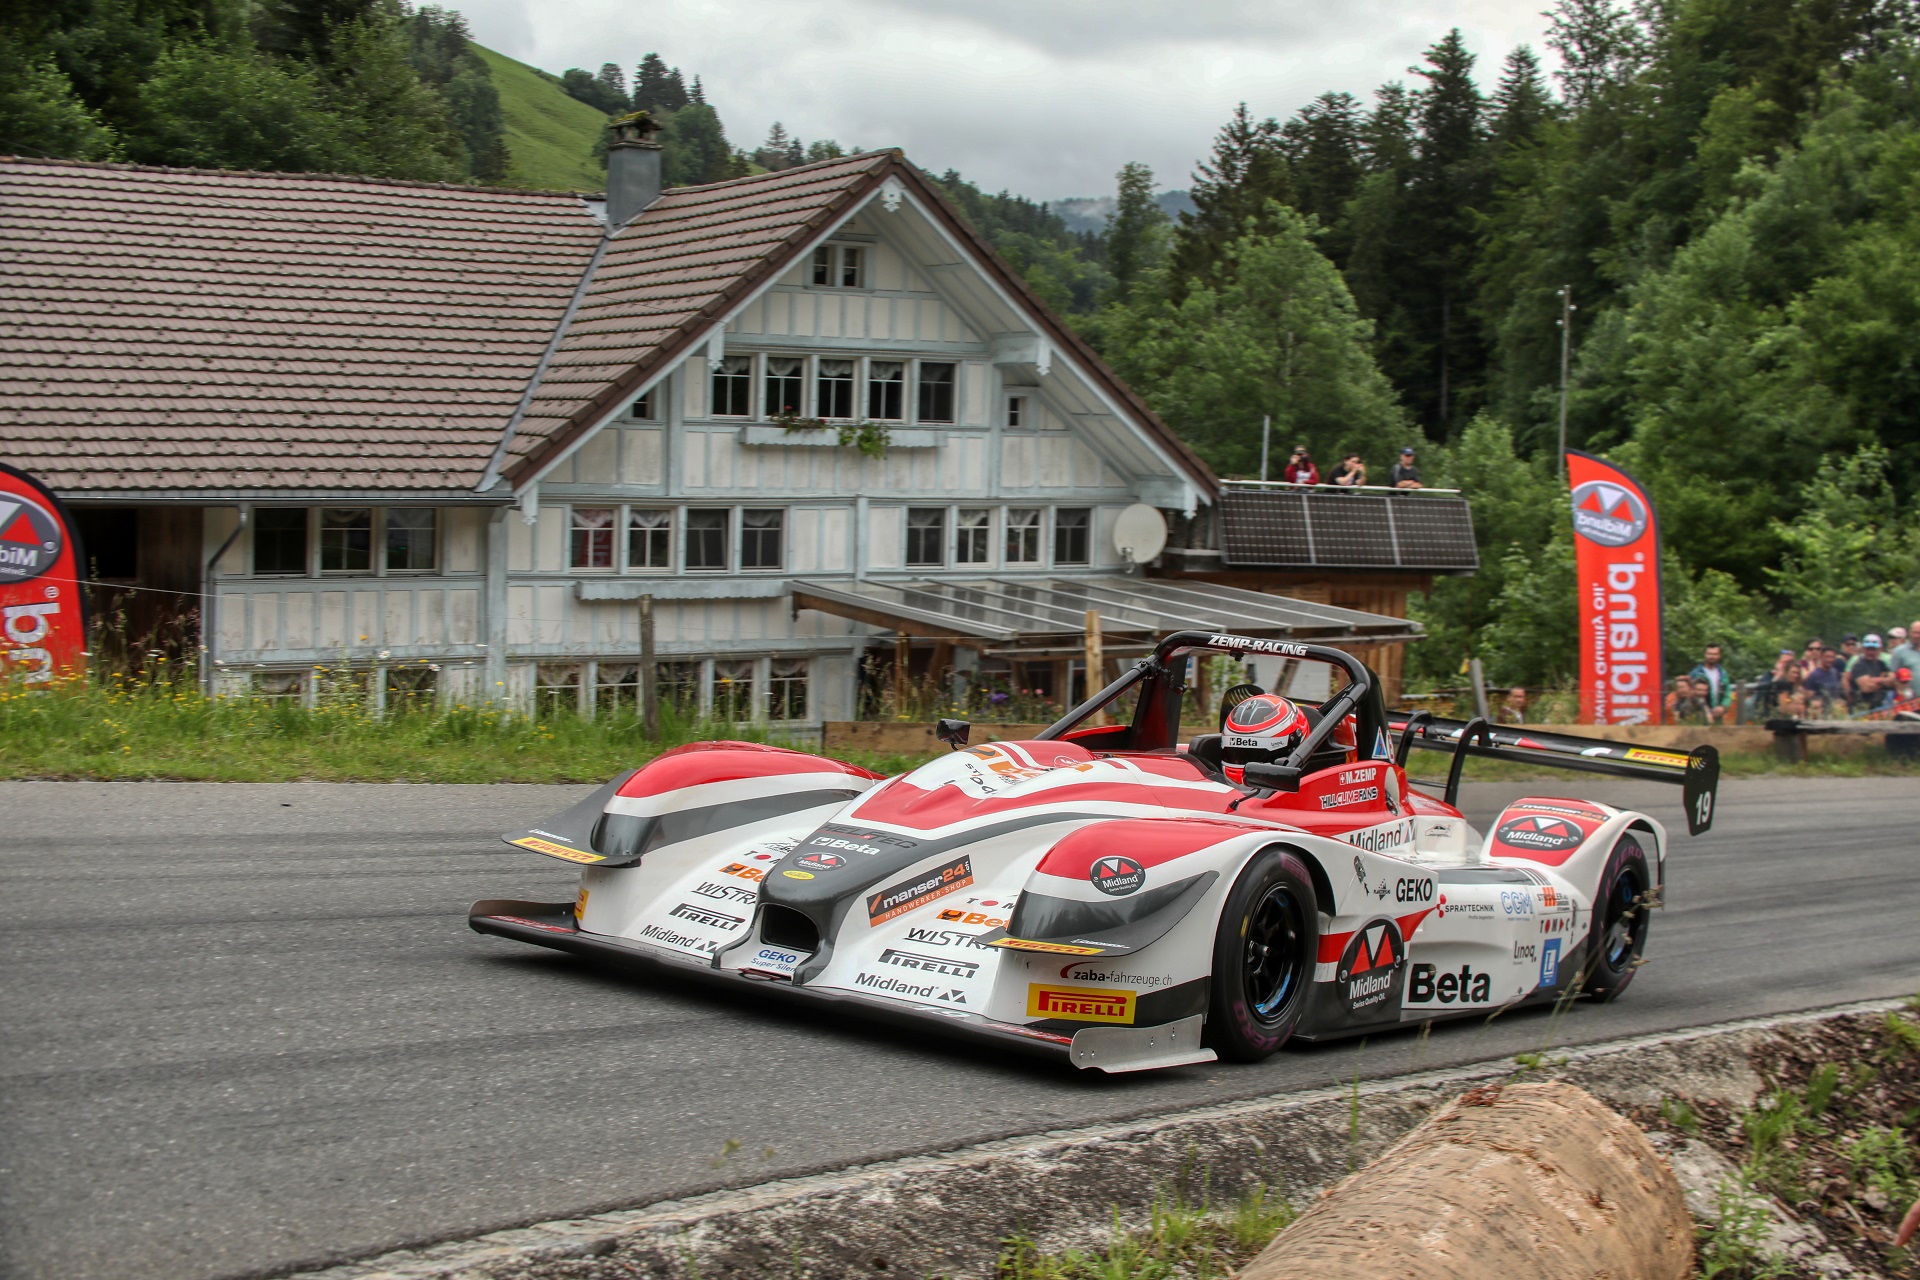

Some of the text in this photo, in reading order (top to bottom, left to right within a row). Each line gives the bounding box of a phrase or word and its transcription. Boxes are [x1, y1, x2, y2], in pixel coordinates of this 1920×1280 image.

[1208, 635, 1309, 656] ZEMP-RACING
[1236, 738, 1258, 747] Beta
[1345, 768, 1377, 785] M.ZEMP
[1695, 791, 1711, 825] 19
[831, 839, 881, 855] Beta
[1349, 823, 1401, 852] Midland
[1506, 831, 1563, 845] Midland
[883, 864, 966, 909] manser24
[1102, 874, 1139, 889] Midland
[1396, 878, 1433, 902] GEKO
[885, 879, 967, 919] HANDWERKER-SHOP
[1444, 904, 1495, 913] SPRAYTECHNIK
[1501, 892, 1534, 915] CGM
[669, 903, 746, 931] PIRELLI
[640, 924, 699, 948] Midland
[751, 958, 775, 968] Super
[758, 949, 797, 963] GEKO
[878, 949, 980, 979] PIRELLI
[855, 972, 937, 998] Midland
[1073, 970, 1173, 987] zaba-fahrzeuge.ch
[1350, 970, 1391, 999] Midland
[1408, 963, 1491, 1003] Beta
[1038, 991, 1127, 1017] PIRELLI
[1353, 1000, 1365, 1009] Swiss
[1365, 995, 1379, 1006] Quality
